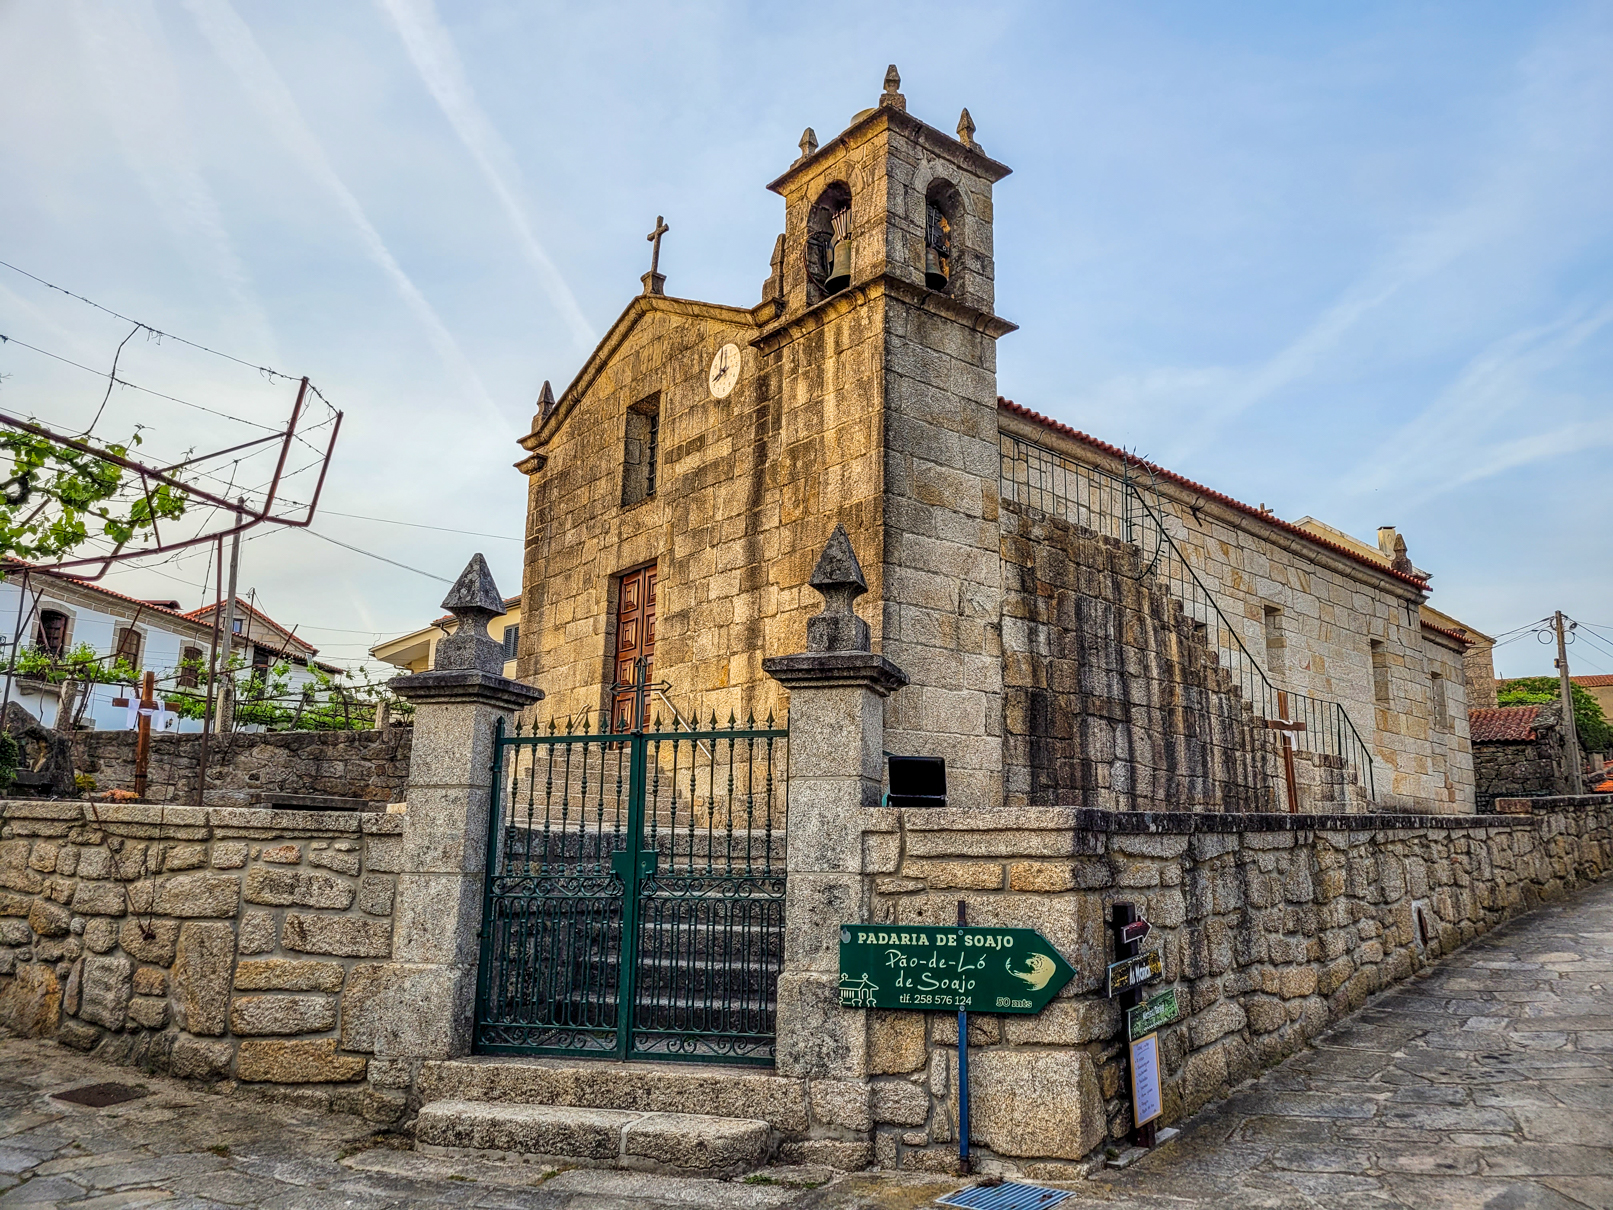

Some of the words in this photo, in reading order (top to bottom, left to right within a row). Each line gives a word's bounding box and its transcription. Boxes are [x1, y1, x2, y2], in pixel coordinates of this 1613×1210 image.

[857, 932, 930, 946] PADARIA
[935, 934, 957, 947] DE
[964, 935, 1014, 951] SOAJO
[884, 949, 987, 973] Pão-de-Ló
[895, 969, 914, 988] de
[917, 972, 976, 993] Soajo
[899, 993, 912, 1004] tlf.
[914, 994, 933, 1004] 258
[934, 995, 953, 1005] 576
[954, 996, 972, 1006] 124
[995, 996, 1011, 1008] 50
[1011, 998, 1033, 1009] mts
